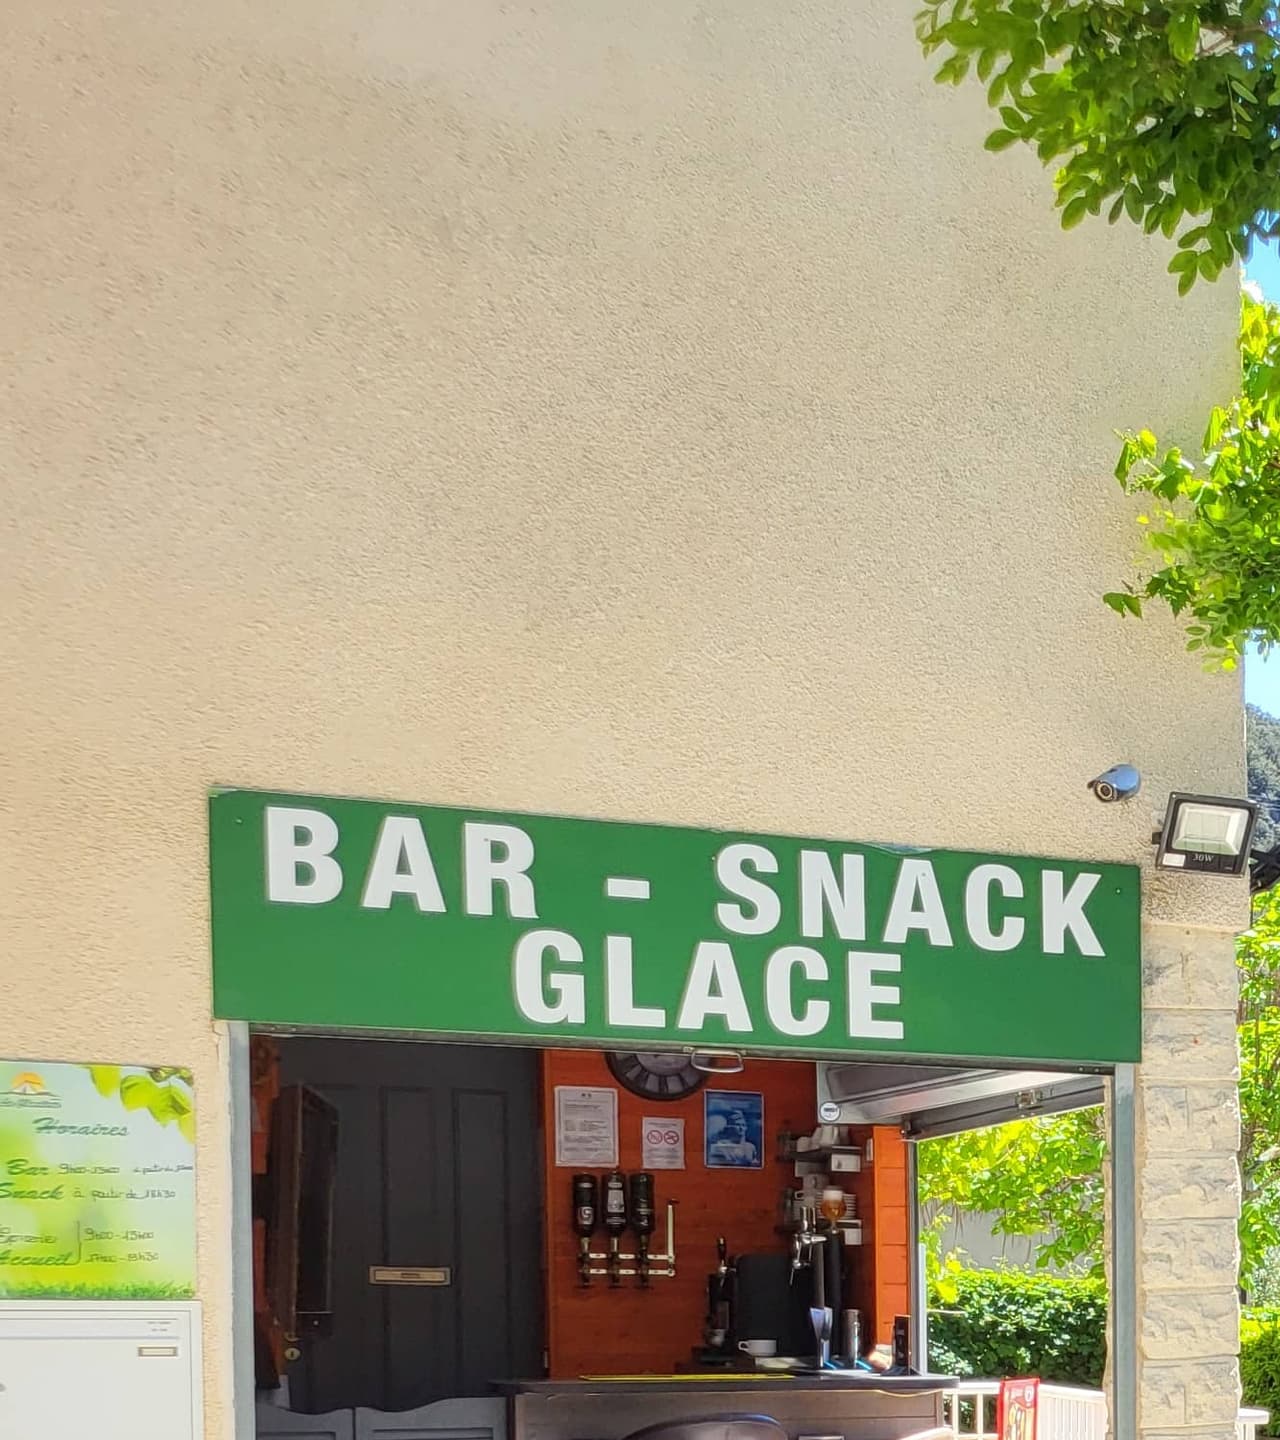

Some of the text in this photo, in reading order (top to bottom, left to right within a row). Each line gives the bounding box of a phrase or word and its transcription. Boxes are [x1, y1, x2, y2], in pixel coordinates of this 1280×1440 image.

[265, 805, 1106, 957] BAR - SNACK
[514, 929, 905, 1040] GLACE
[33, 1117, 128, 1136] Horaires
[7, 1159, 48, 1175] Bar
[0, 1182, 64, 1199] Snack
